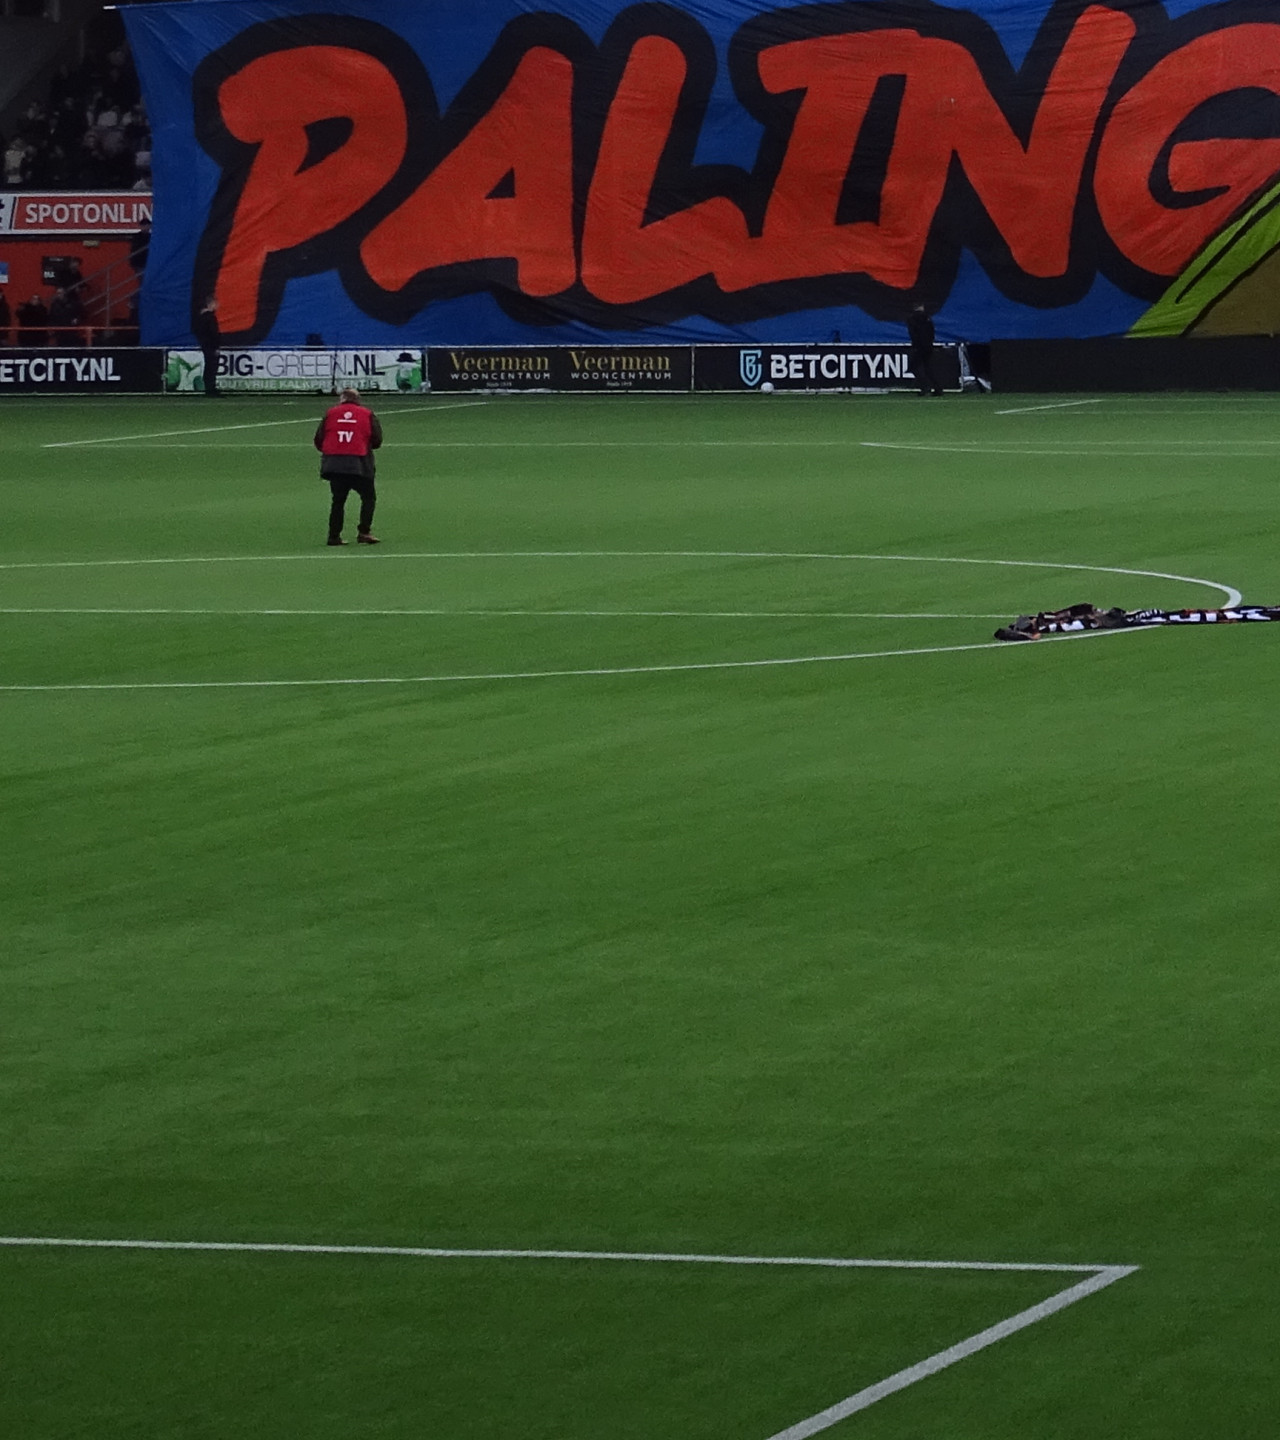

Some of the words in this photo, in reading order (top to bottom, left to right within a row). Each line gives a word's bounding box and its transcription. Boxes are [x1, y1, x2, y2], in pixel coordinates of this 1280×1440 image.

[450, 351, 549, 371] Veerman
[569, 351, 671, 370] Veerman
[770, 353, 916, 379] BETCITY.NL
[451, 372, 550, 380] WOONCENTRUM
[571, 371, 672, 380] WOONCENTRUM
[337, 430, 354, 443] TV
